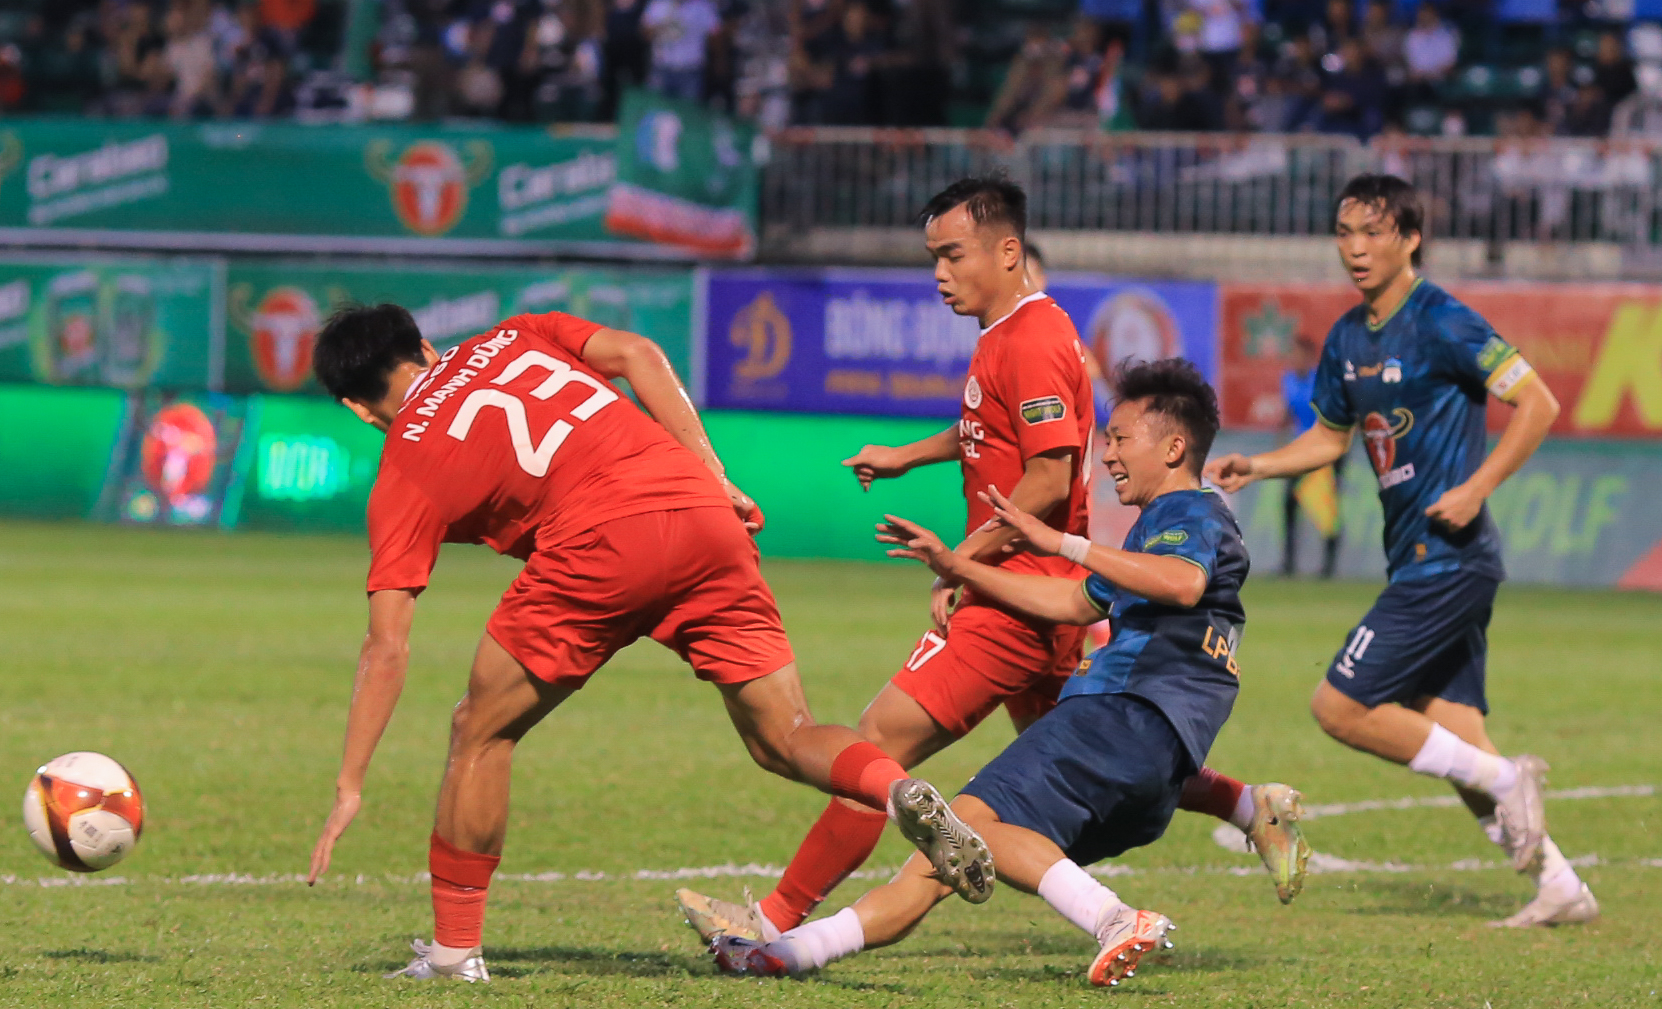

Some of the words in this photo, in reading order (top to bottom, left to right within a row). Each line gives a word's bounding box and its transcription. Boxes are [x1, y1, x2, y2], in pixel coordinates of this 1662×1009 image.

[465, 329, 518, 370] DŨNG
[415, 367, 479, 418] MẠNH
[402, 420, 430, 442] N.
[446, 349, 620, 478] 23
[1346, 625, 1376, 661] 11
